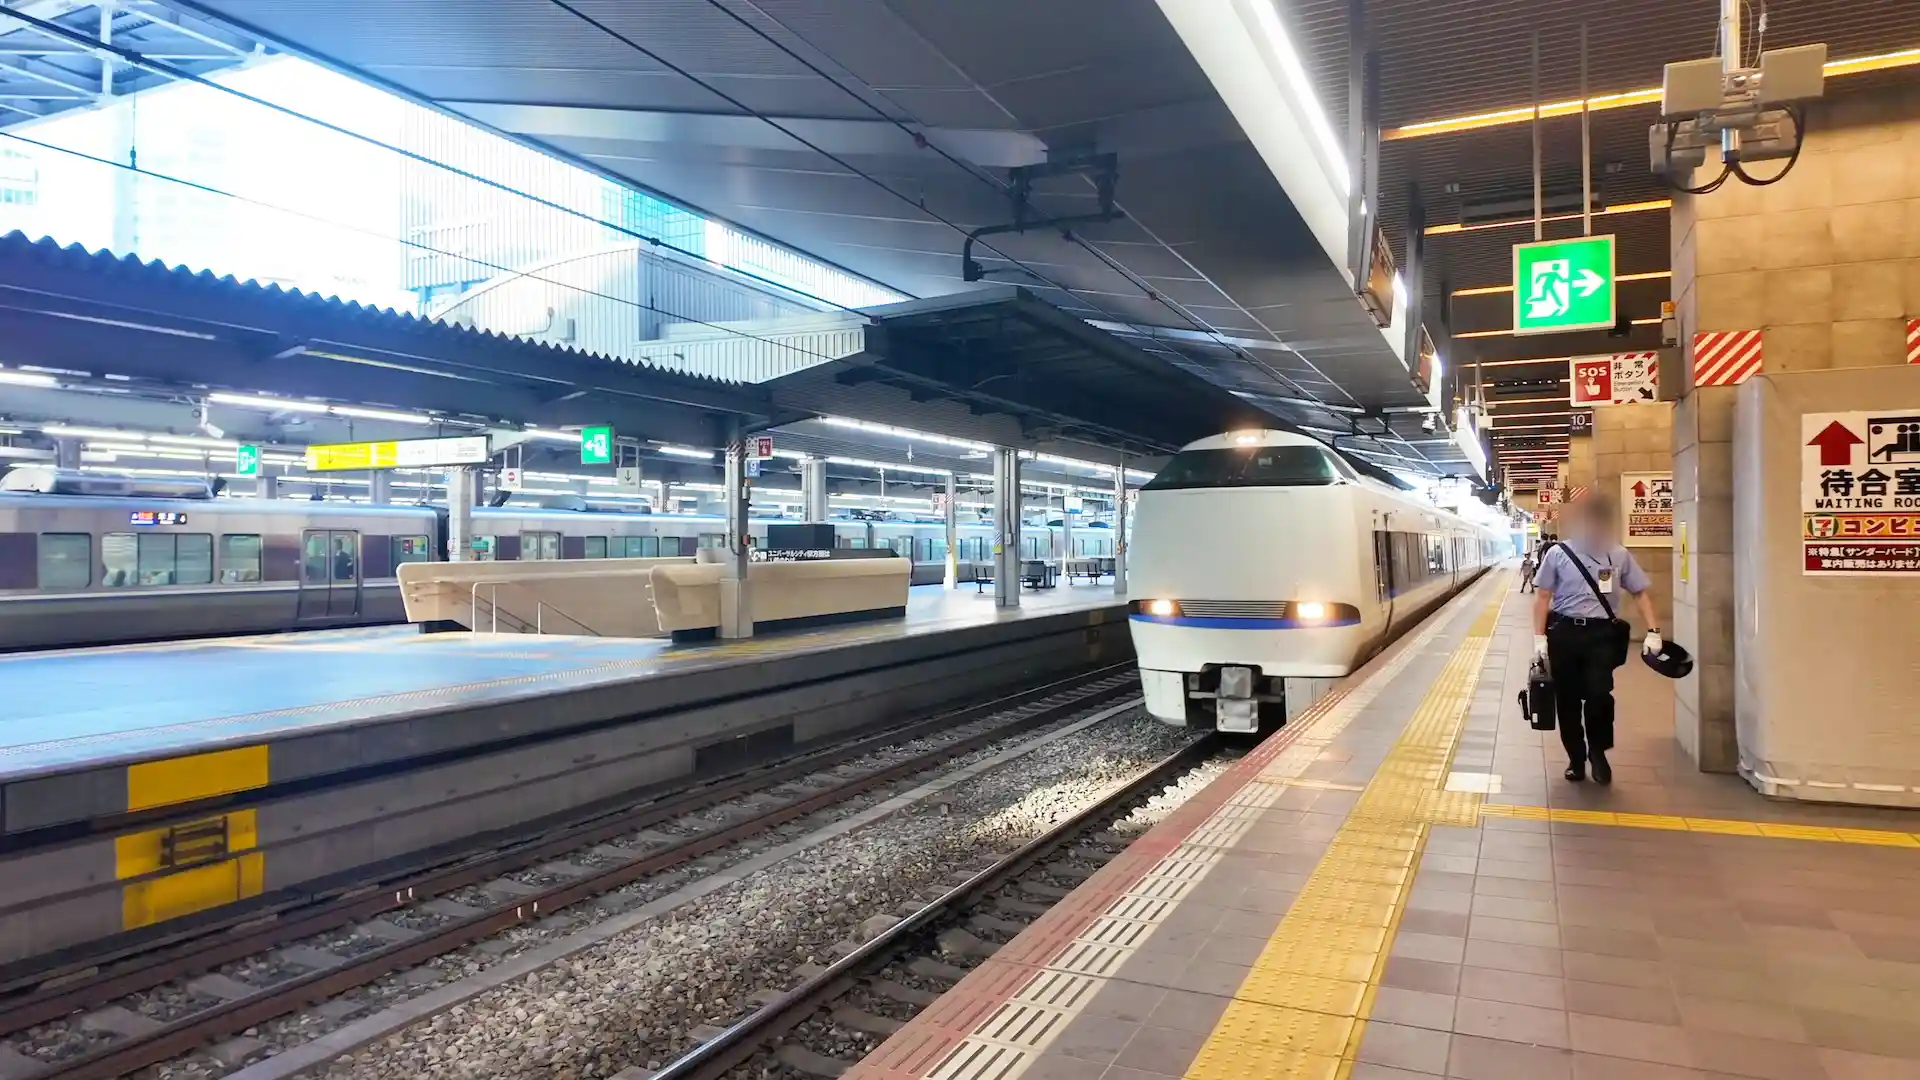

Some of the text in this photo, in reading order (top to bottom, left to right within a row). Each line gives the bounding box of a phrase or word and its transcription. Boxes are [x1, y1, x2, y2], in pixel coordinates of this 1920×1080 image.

[1578, 366, 1608, 378] SOS
[1614, 370, 1644, 380] ボタン
[1571, 414, 1586, 426] 10
[1820, 467, 1920, 497] 待合室
[1634, 498, 1672, 509] 待合室
[1815, 498, 1883, 509] WAITING
